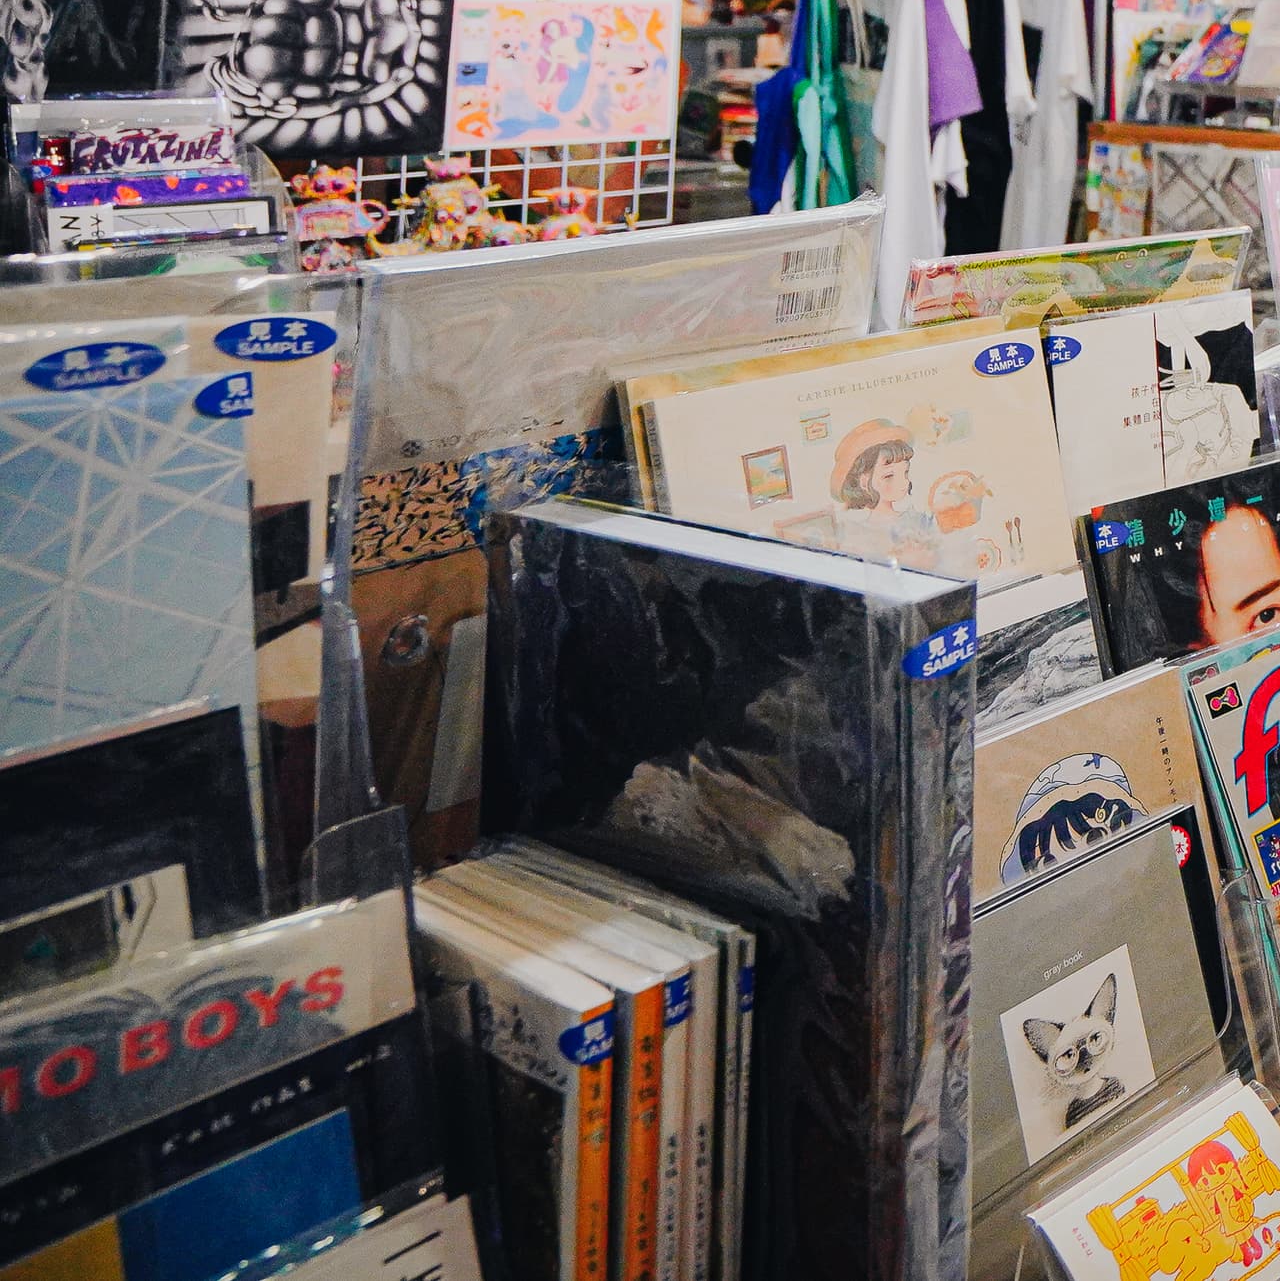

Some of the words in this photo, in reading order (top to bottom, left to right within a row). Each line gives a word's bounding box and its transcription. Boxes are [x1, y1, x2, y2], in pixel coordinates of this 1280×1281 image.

[250, 320, 308, 341] 見本
[236, 338, 314, 356] SAMPLE
[988, 342, 1019, 363] 見本
[54, 362, 144, 387] SAMPLE
[987, 357, 1026, 374] SAMPLE
[796, 385, 847, 403] CARRIE
[851, 366, 940, 394] ILLUSTRATION
[928, 624, 969, 657] 見本
[921, 642, 976, 677] SAMPLE
[117, 964, 345, 1079] BOYS
